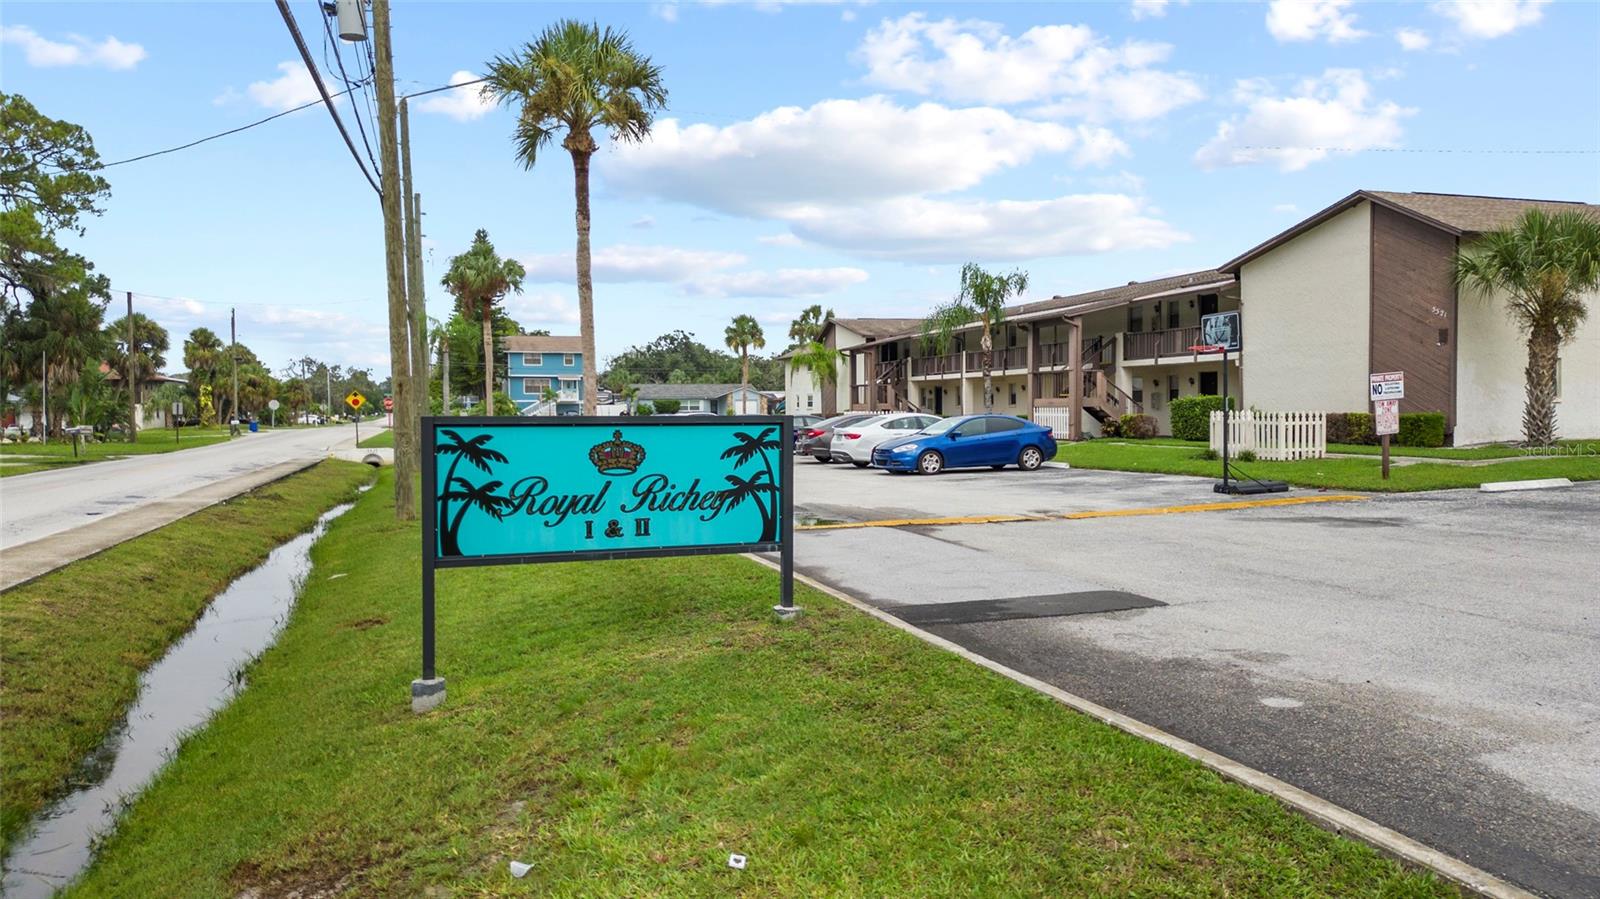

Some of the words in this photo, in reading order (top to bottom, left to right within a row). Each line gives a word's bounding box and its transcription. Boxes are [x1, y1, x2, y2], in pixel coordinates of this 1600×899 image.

[1372, 384, 1383, 395] NO
[499, 476, 612, 527] Royal
[620, 473, 728, 521] Richey
[585, 520, 594, 539] I
[604, 519, 624, 538] &
[635, 518, 650, 537] II
